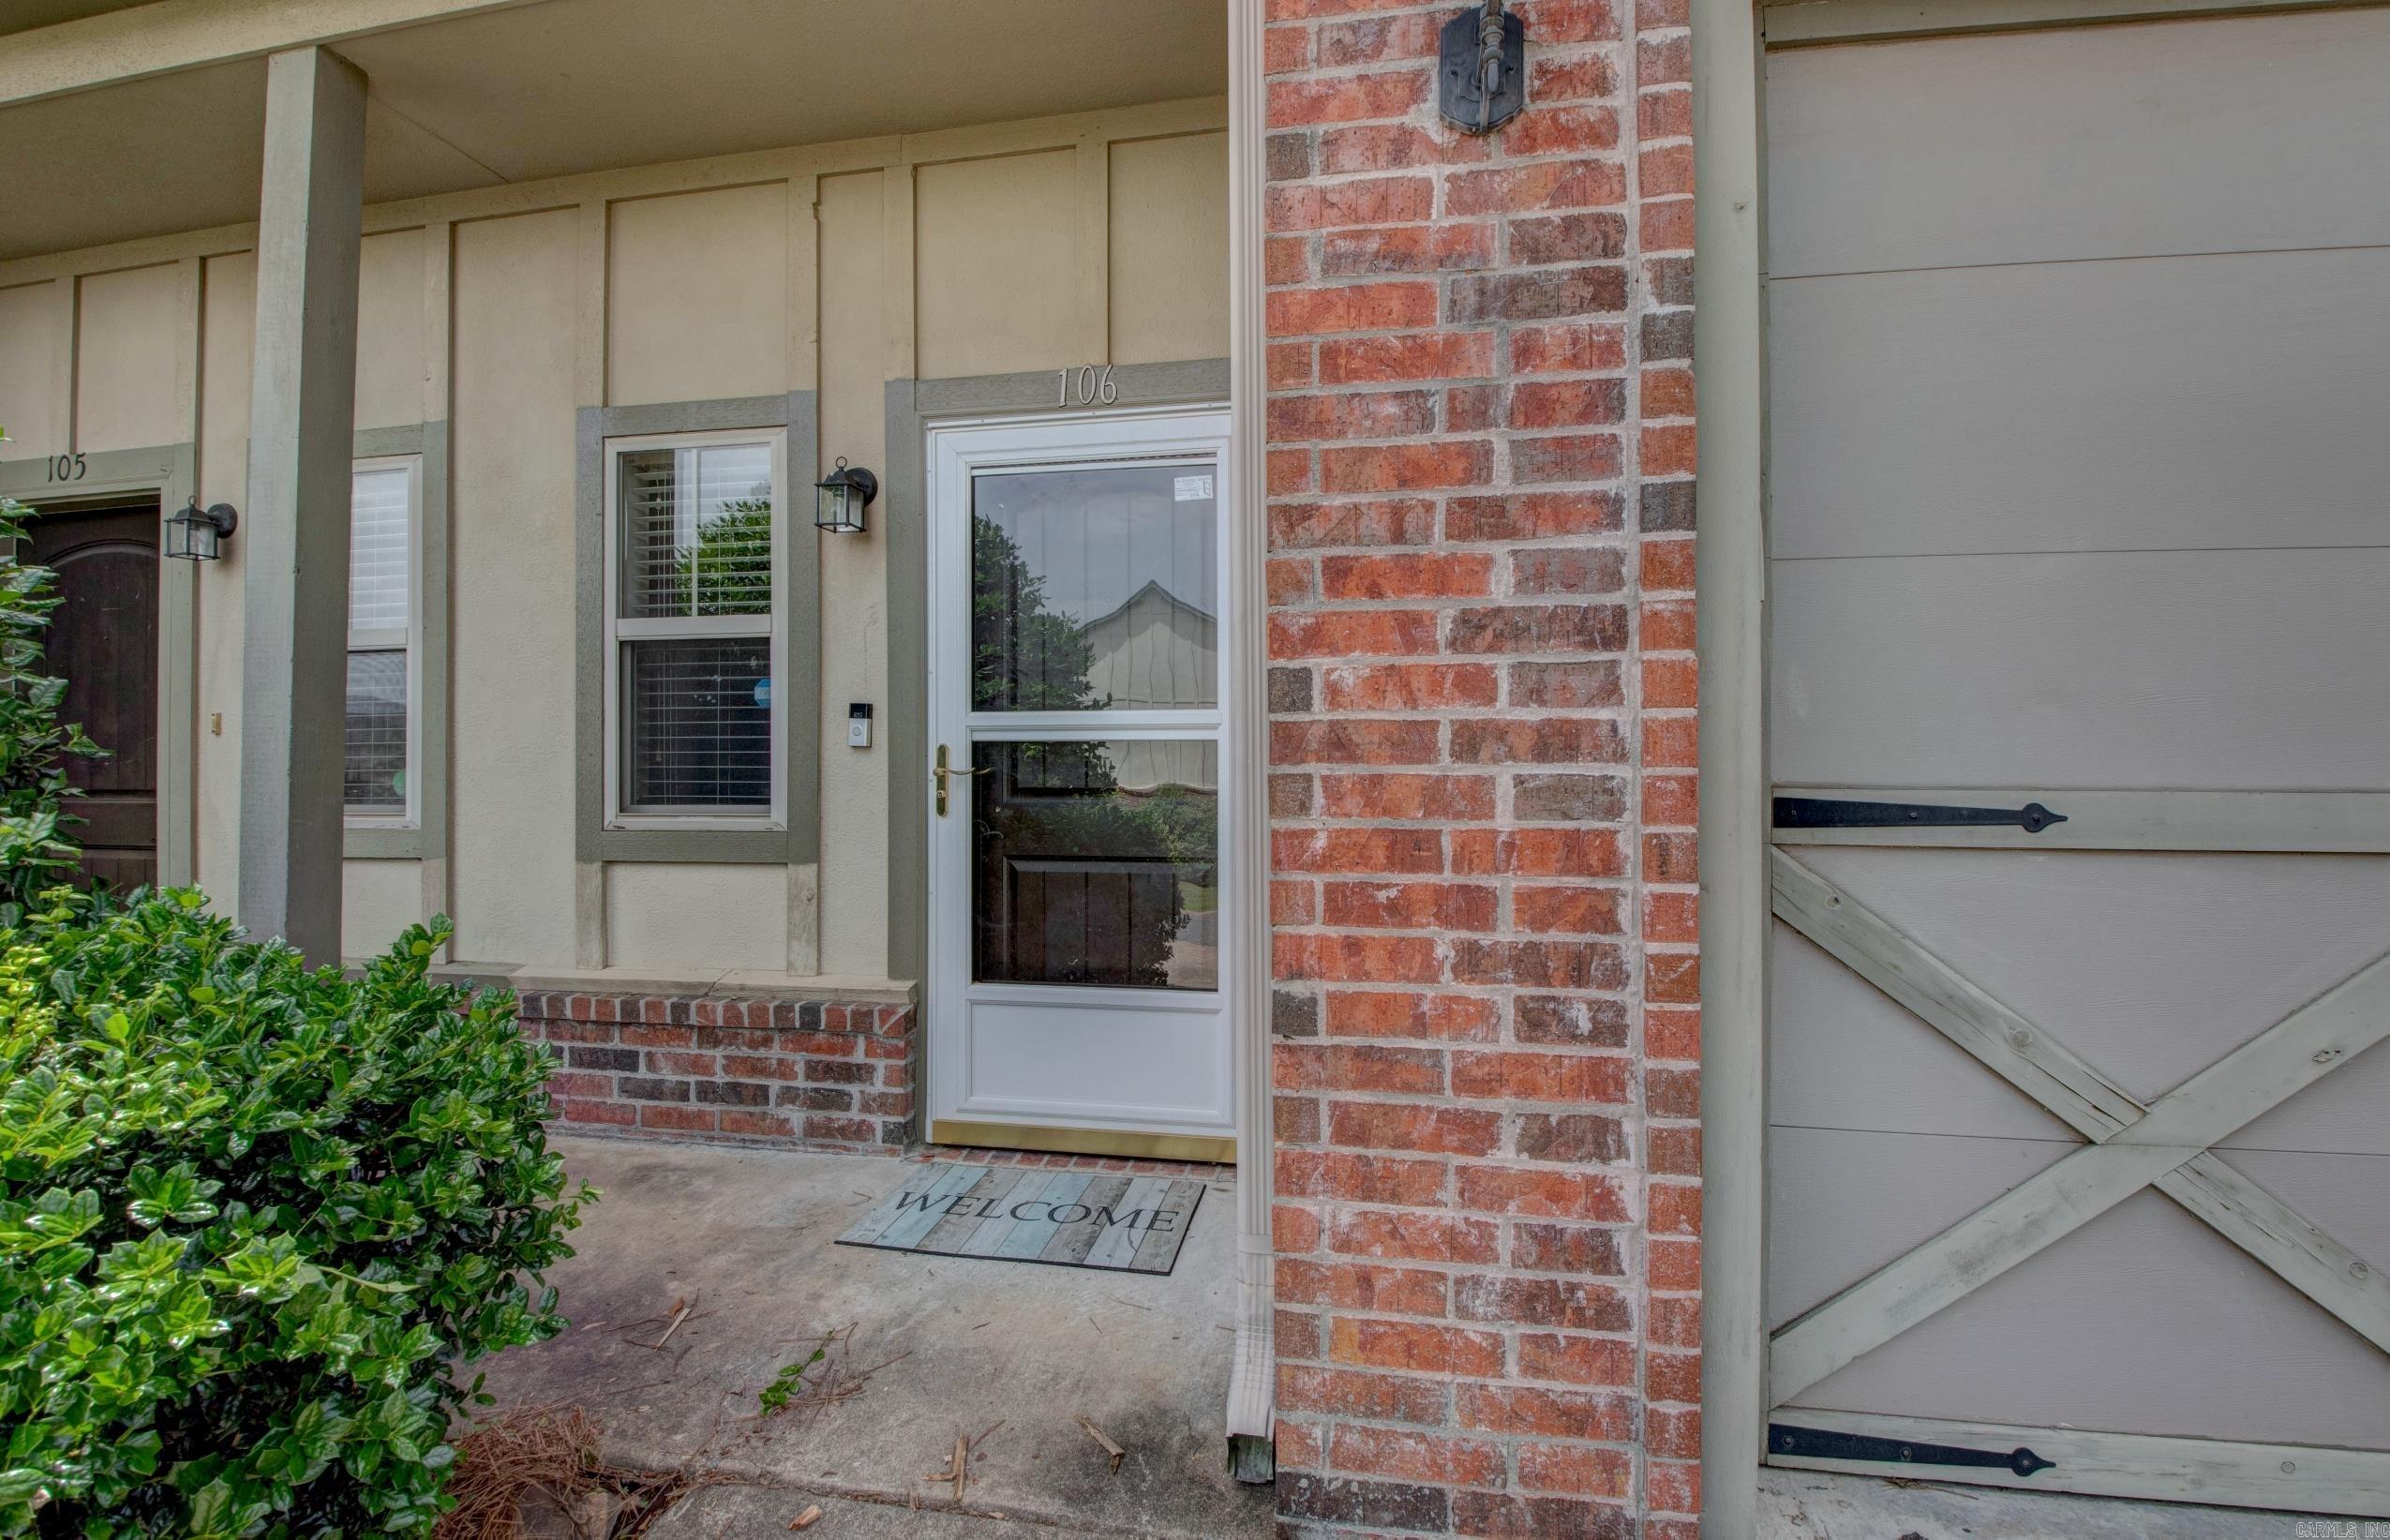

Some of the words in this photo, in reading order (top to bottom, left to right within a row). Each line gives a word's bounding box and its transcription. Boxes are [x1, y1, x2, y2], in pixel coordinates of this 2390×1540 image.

[1057, 364, 1118, 408] 106
[48, 452, 86, 483] 105
[894, 1190, 1181, 1233] WELCOME
